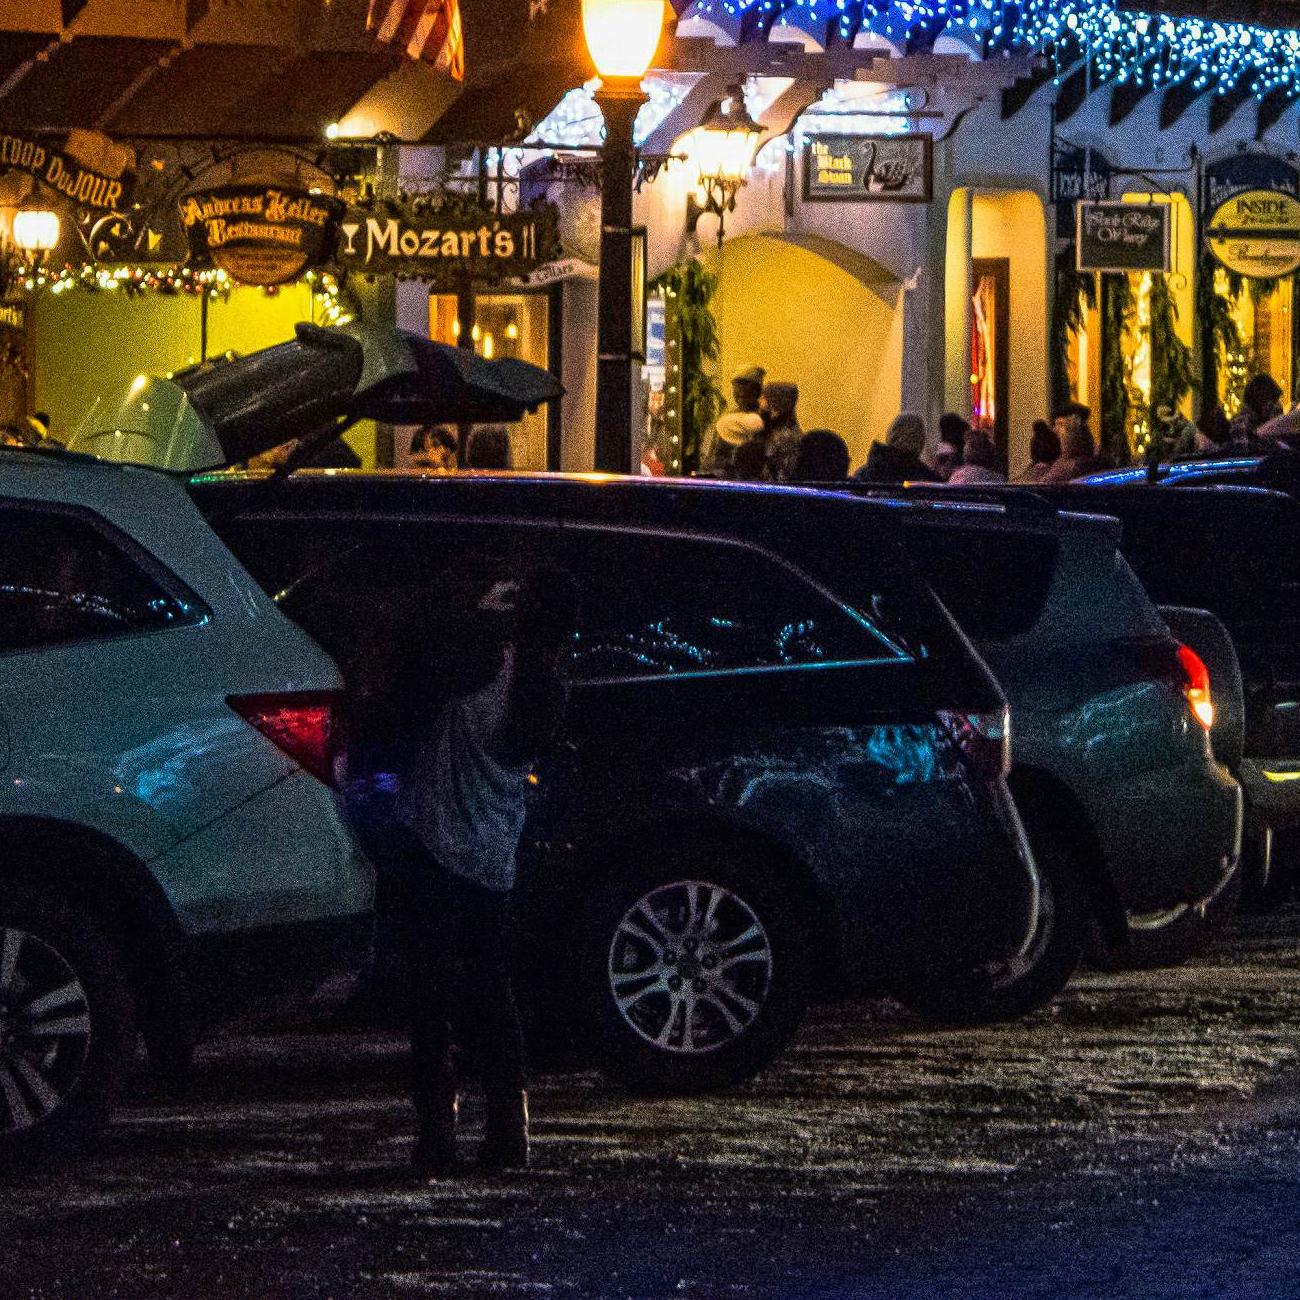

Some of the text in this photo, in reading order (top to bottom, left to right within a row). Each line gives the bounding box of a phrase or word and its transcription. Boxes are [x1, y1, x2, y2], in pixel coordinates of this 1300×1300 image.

[817, 154, 853, 171] Black
[818, 170, 853, 185] Swan
[181, 189, 329, 227] Andreas Keller
[1236, 199, 1288, 214] INSIDE
[365, 217, 516, 265] Mozart's
